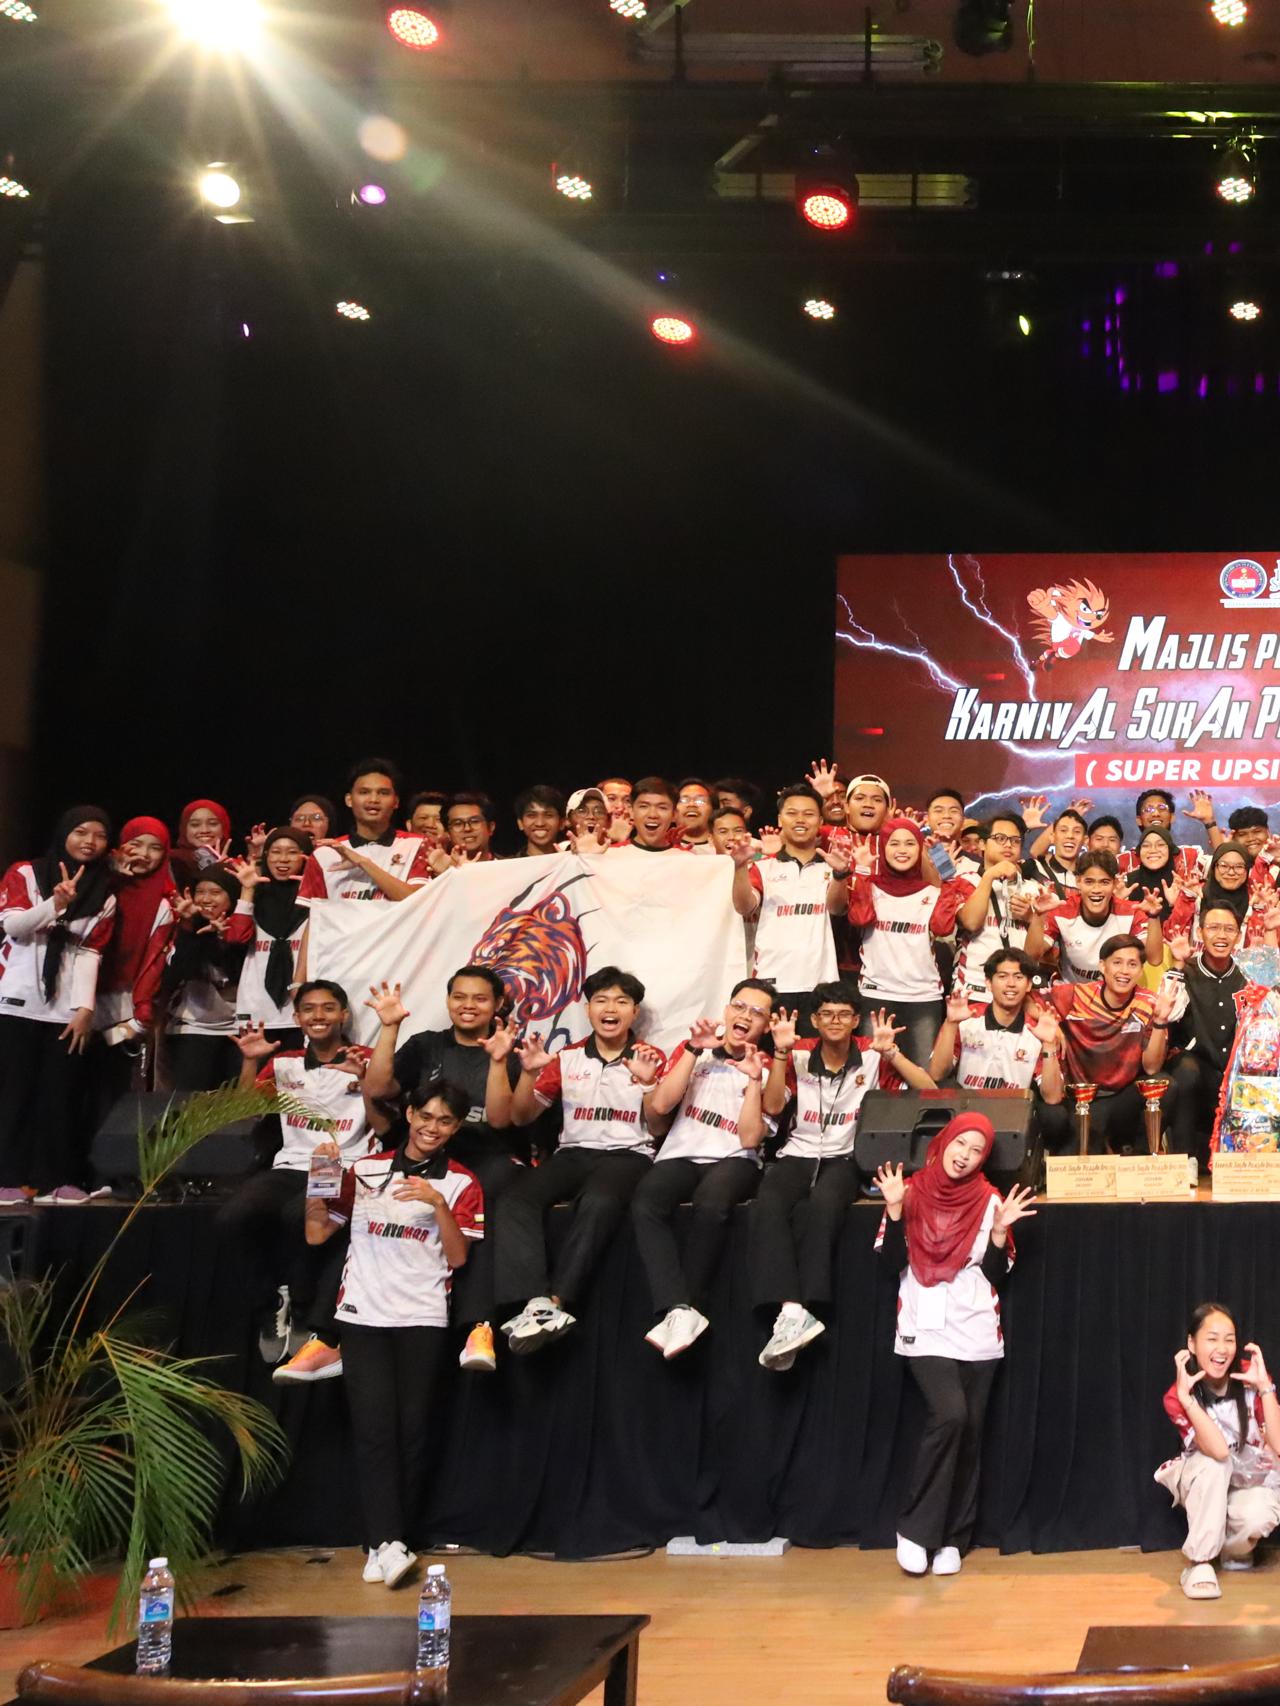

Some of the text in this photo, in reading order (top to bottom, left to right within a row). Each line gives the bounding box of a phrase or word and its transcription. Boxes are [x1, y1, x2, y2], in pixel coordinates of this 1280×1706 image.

[1117, 615, 1250, 671] MAJLIS
[1105, 759, 1200, 781] SUPER
[1211, 759, 1280, 781] UPSI
[573, 1106, 637, 1123] UNGKUOMAR
